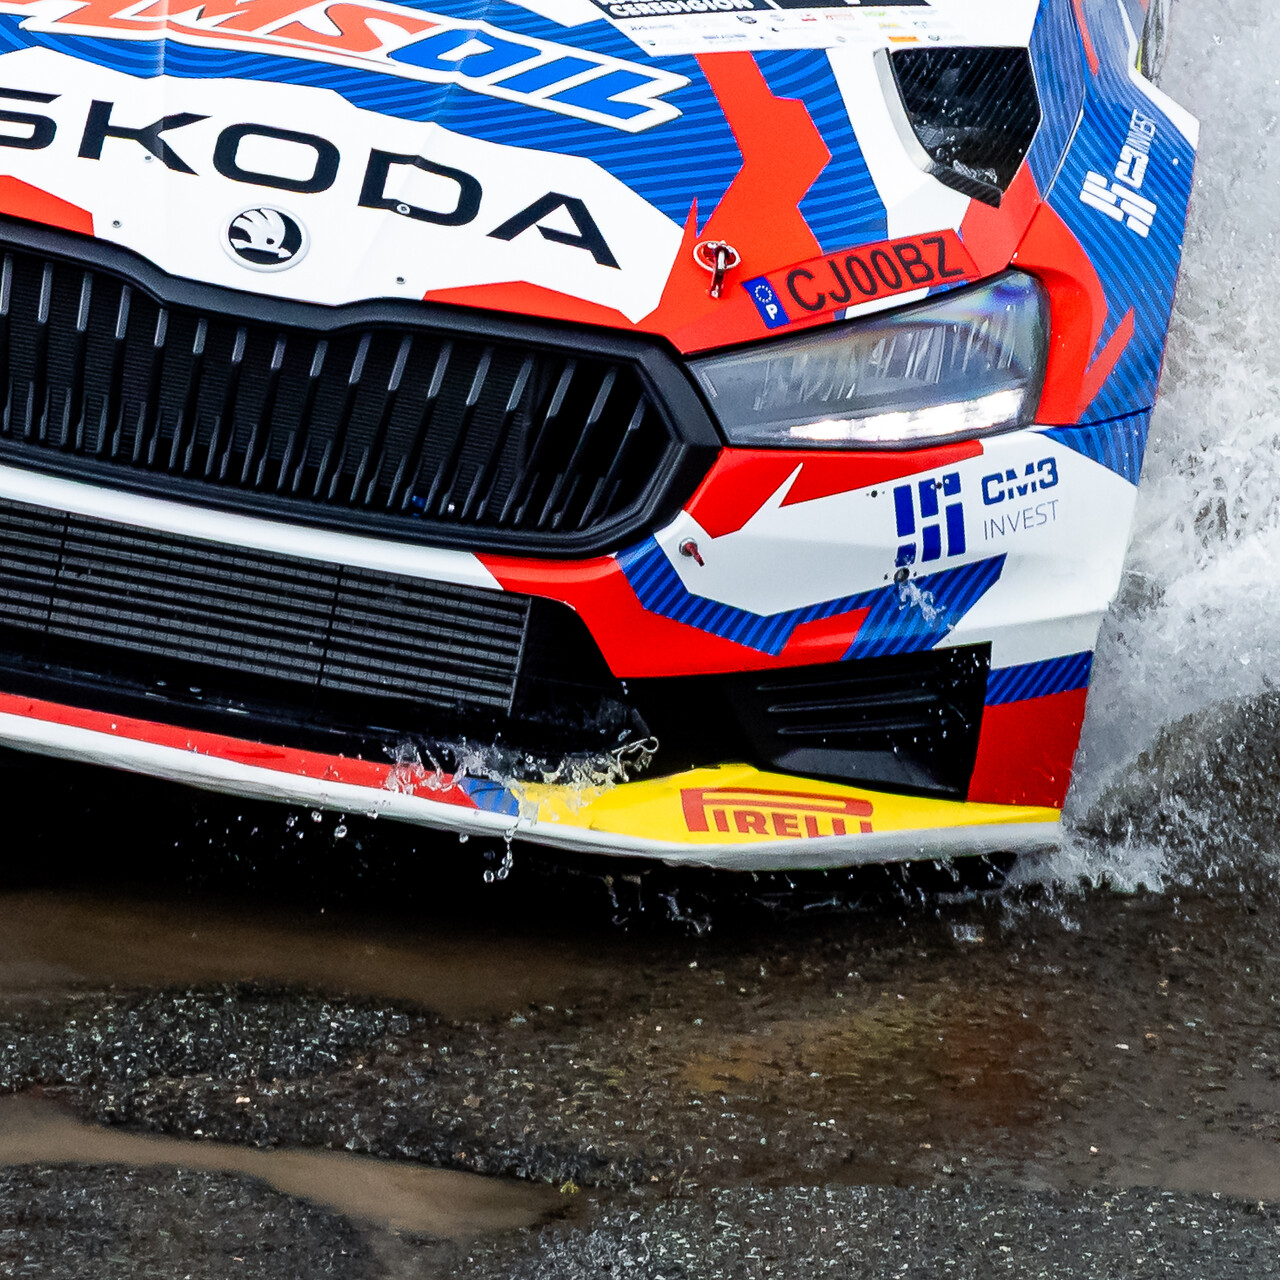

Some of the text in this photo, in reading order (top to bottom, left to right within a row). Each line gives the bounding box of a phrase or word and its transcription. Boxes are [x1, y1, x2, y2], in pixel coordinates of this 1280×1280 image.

[765, 303, 779, 320] P
[981, 456, 1059, 506] CM3
[983, 498, 1060, 541] INVEST
[679, 786, 875, 839] PIRELLI
